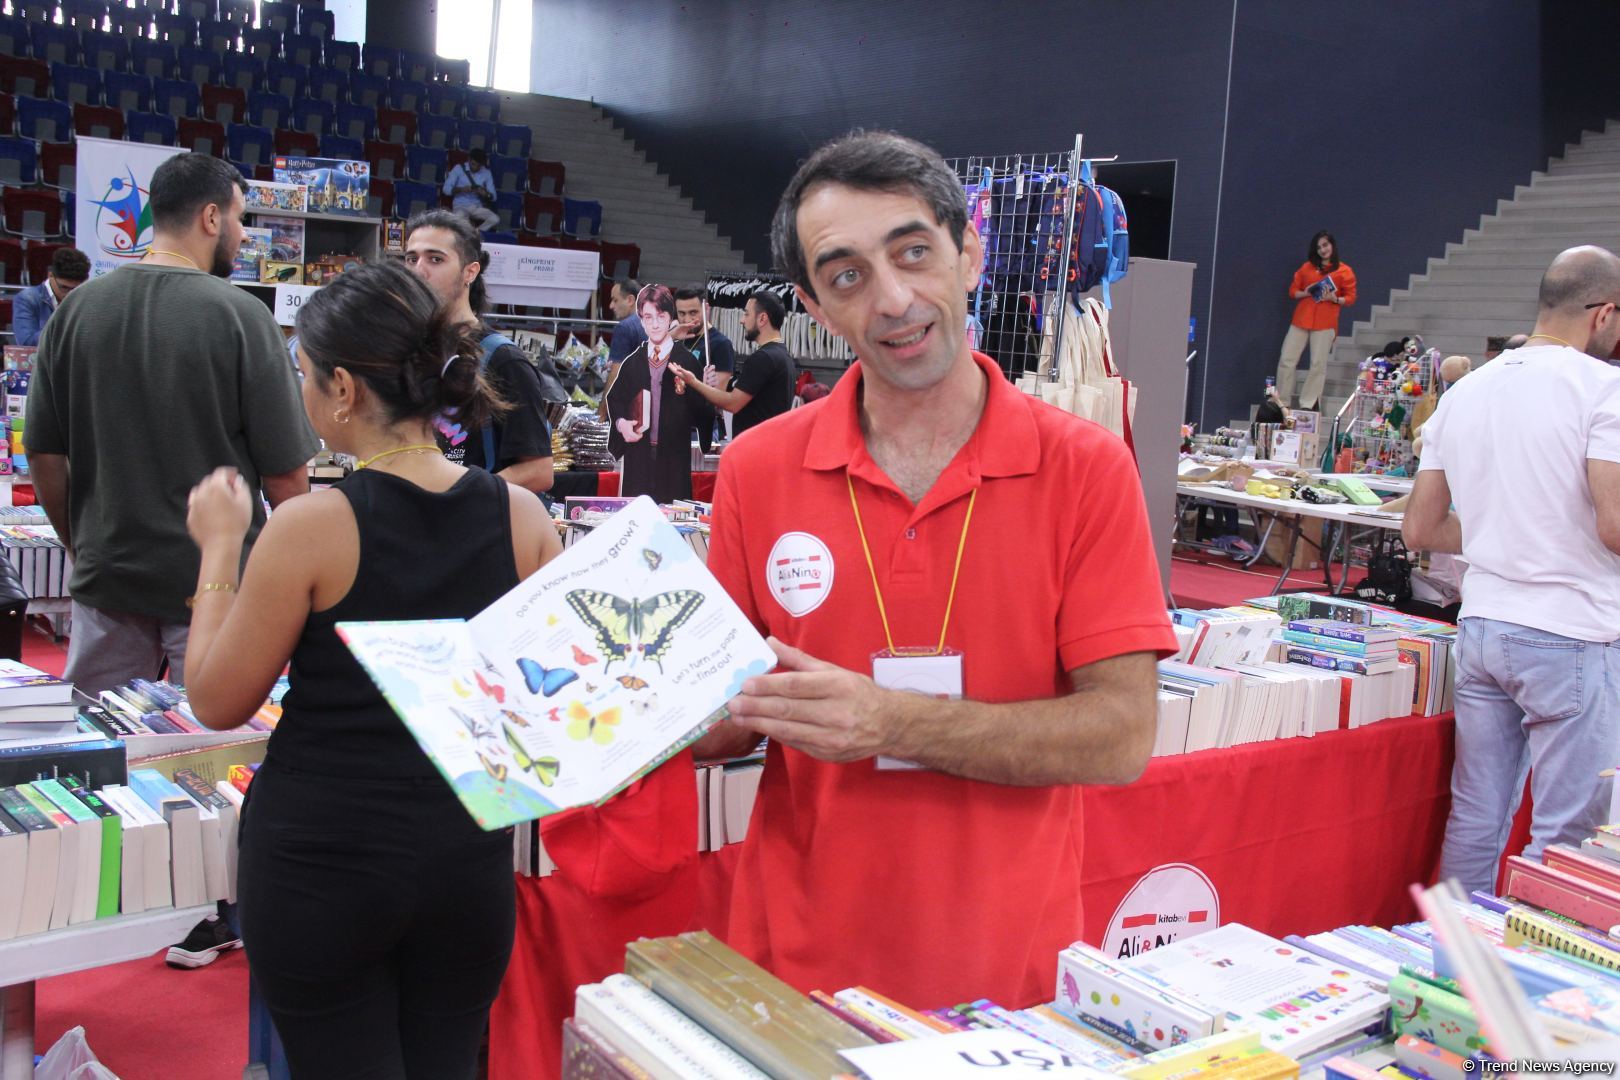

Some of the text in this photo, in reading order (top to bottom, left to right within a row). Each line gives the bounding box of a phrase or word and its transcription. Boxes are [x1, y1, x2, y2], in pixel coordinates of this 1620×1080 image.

[286, 294, 302, 306] 30
[516, 604, 529, 618] Do
[542, 574, 569, 591] know
[571, 567, 590, 578] how
[608, 519, 639, 558] grow?
[689, 655, 711, 670] turn
[720, 628, 737, 650] page
[696, 664, 717, 681] find
